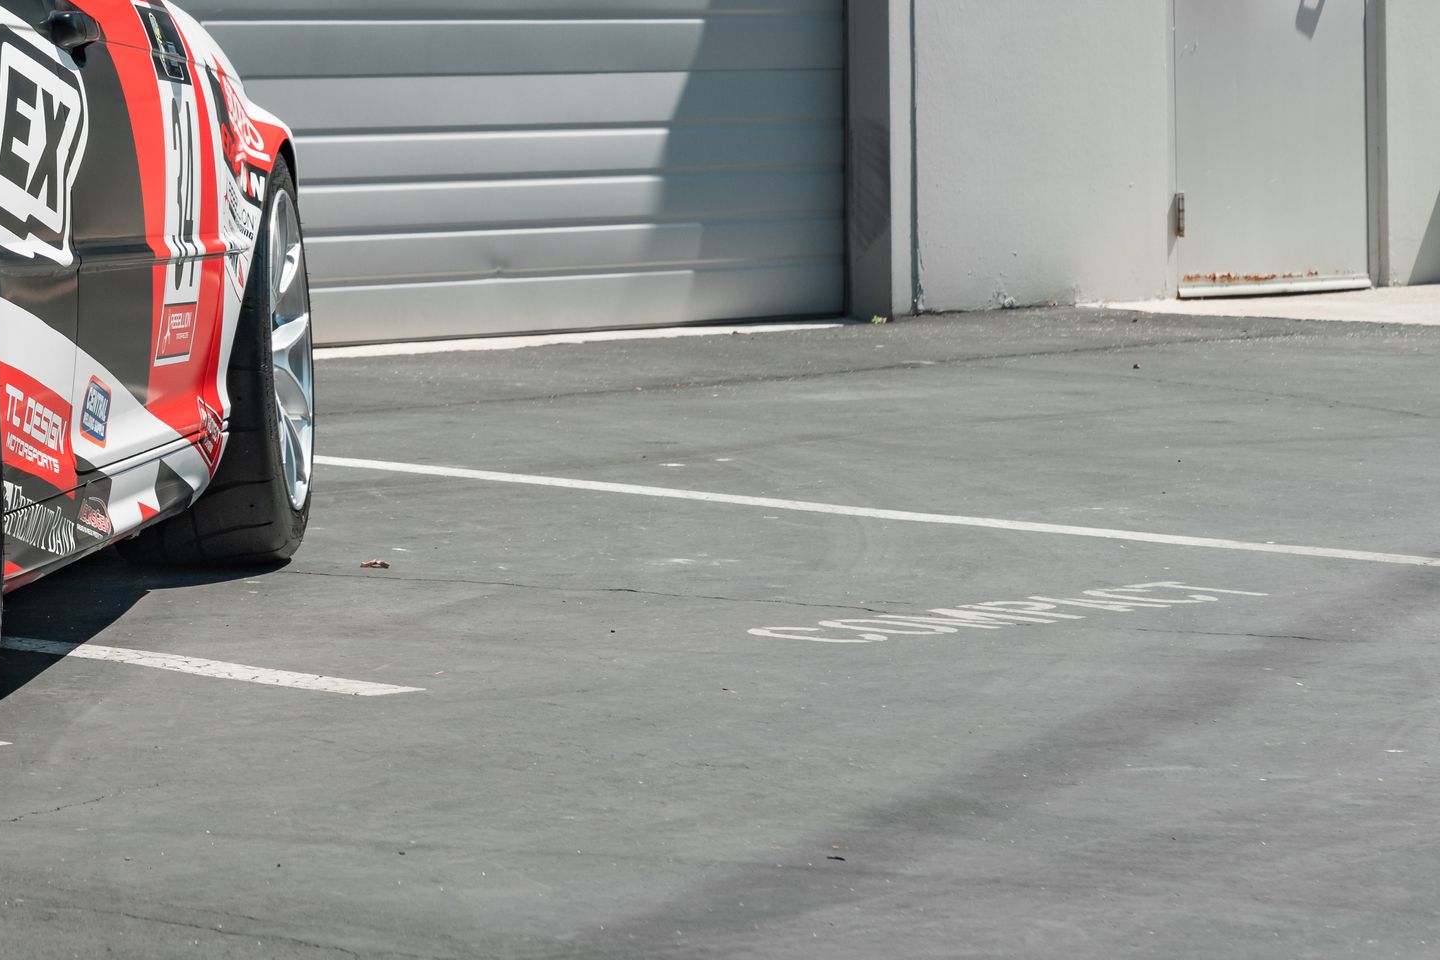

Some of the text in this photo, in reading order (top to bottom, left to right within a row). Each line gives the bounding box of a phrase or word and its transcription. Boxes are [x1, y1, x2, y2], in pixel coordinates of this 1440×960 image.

[172, 98, 198, 290] 34
[5, 383, 24, 427] TC
[23, 396, 67, 454] DESIGN
[6, 431, 60, 474] MOTORSPORTS
[48, 506, 76, 556] BANK
[747, 581, 1268, 643] COMPACT
